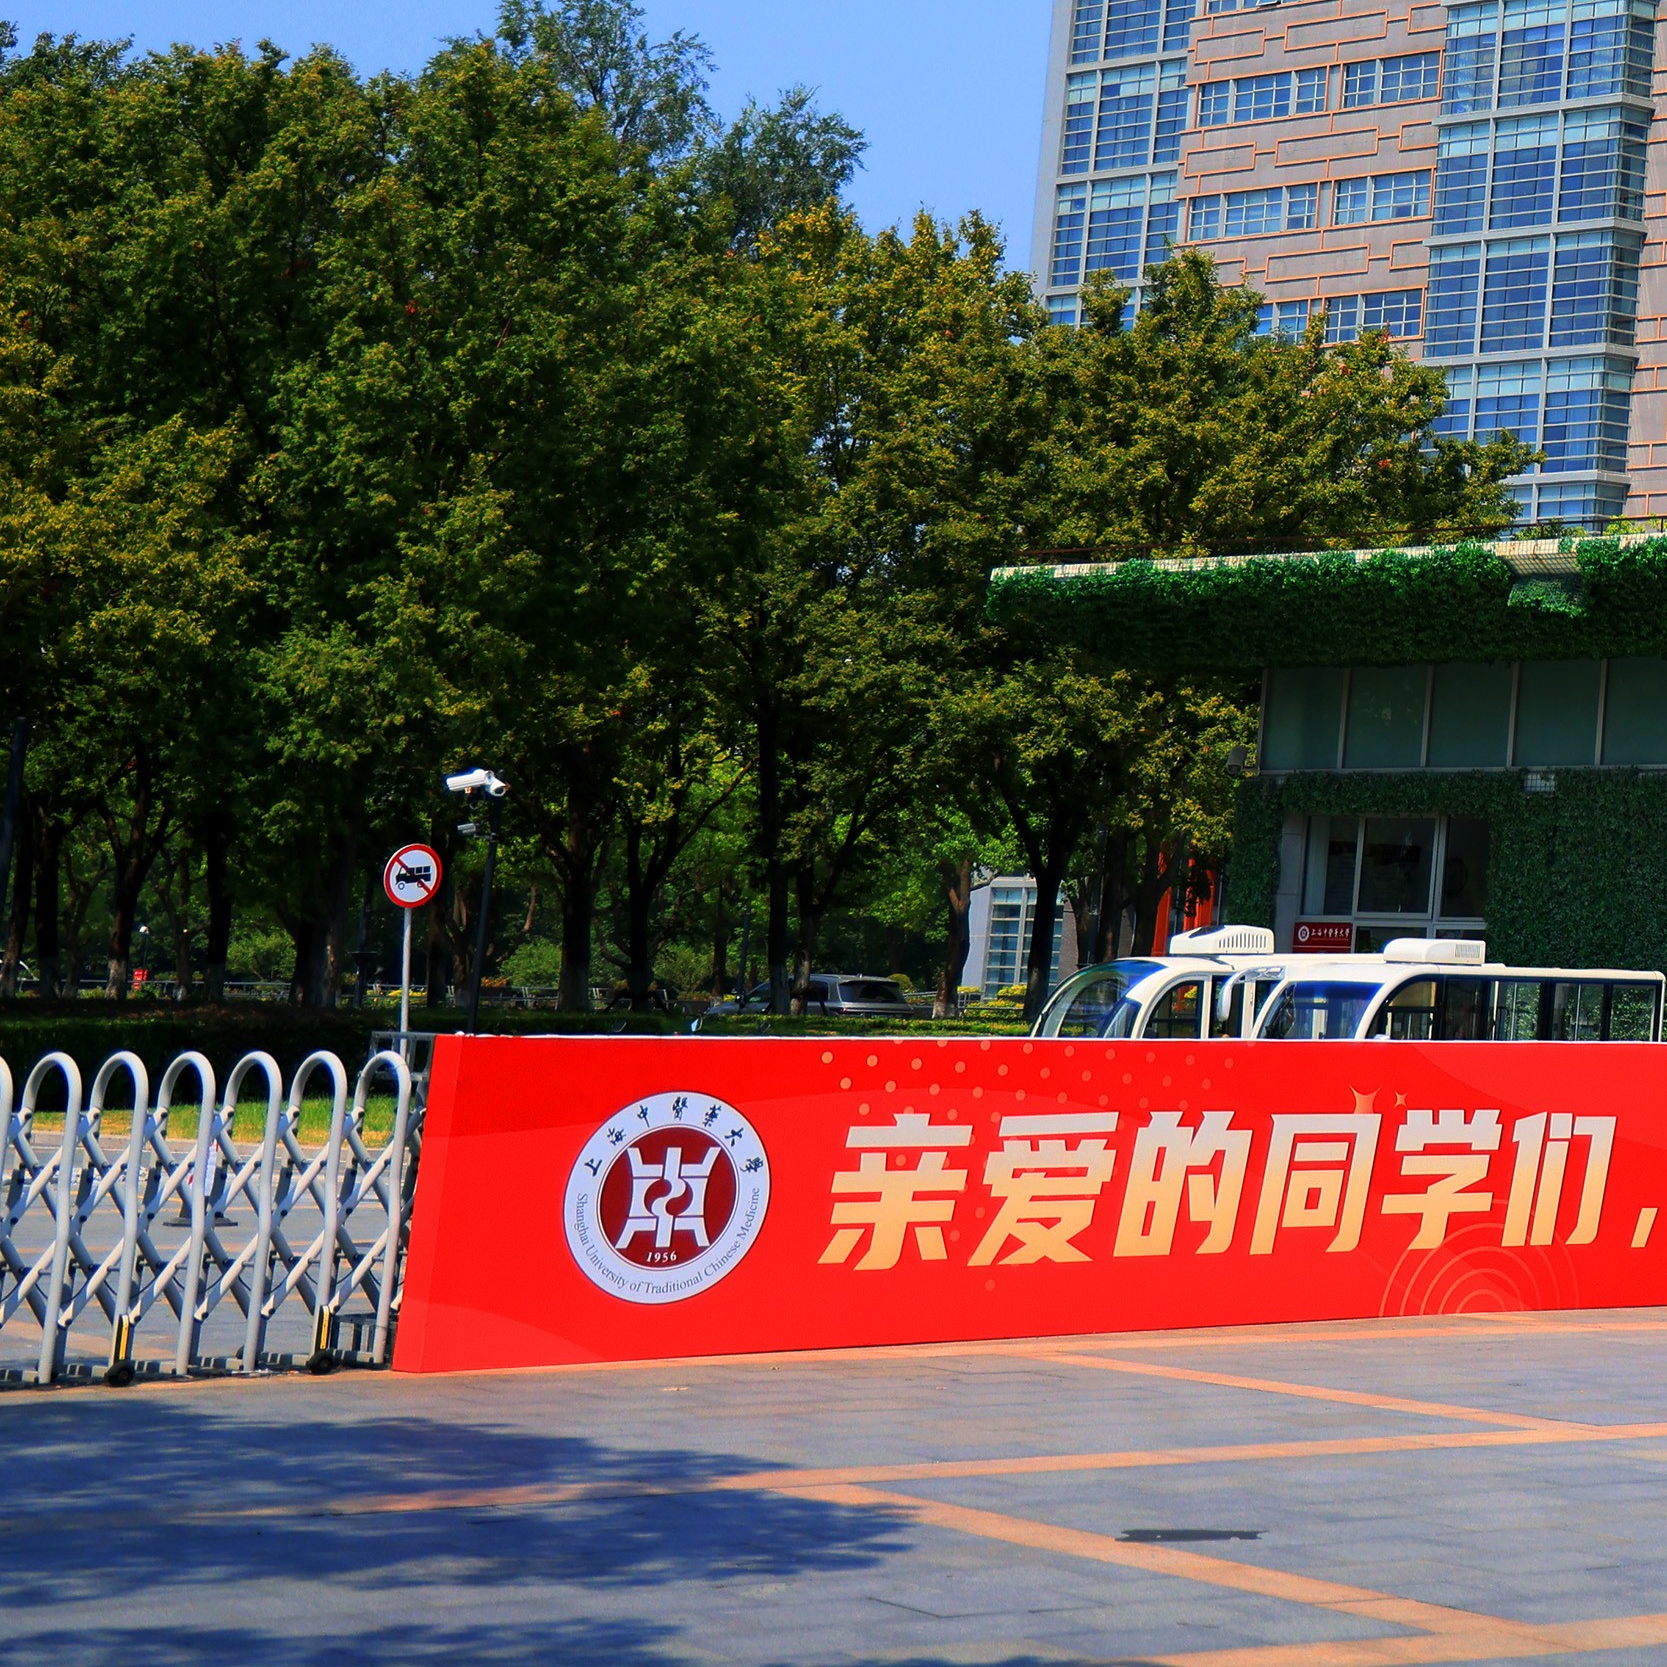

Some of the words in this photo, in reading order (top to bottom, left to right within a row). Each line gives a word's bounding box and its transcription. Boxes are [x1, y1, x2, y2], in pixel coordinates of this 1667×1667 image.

[573, 1193, 588, 1247] Shanghai
[585, 1244, 629, 1289] University
[629, 1281, 643, 1292] of
[644, 1271, 703, 1294] Traditional
[704, 1240, 741, 1277] Chinese
[738, 1187, 760, 1241] Medicine
[646, 1251, 677, 1263] 1956
